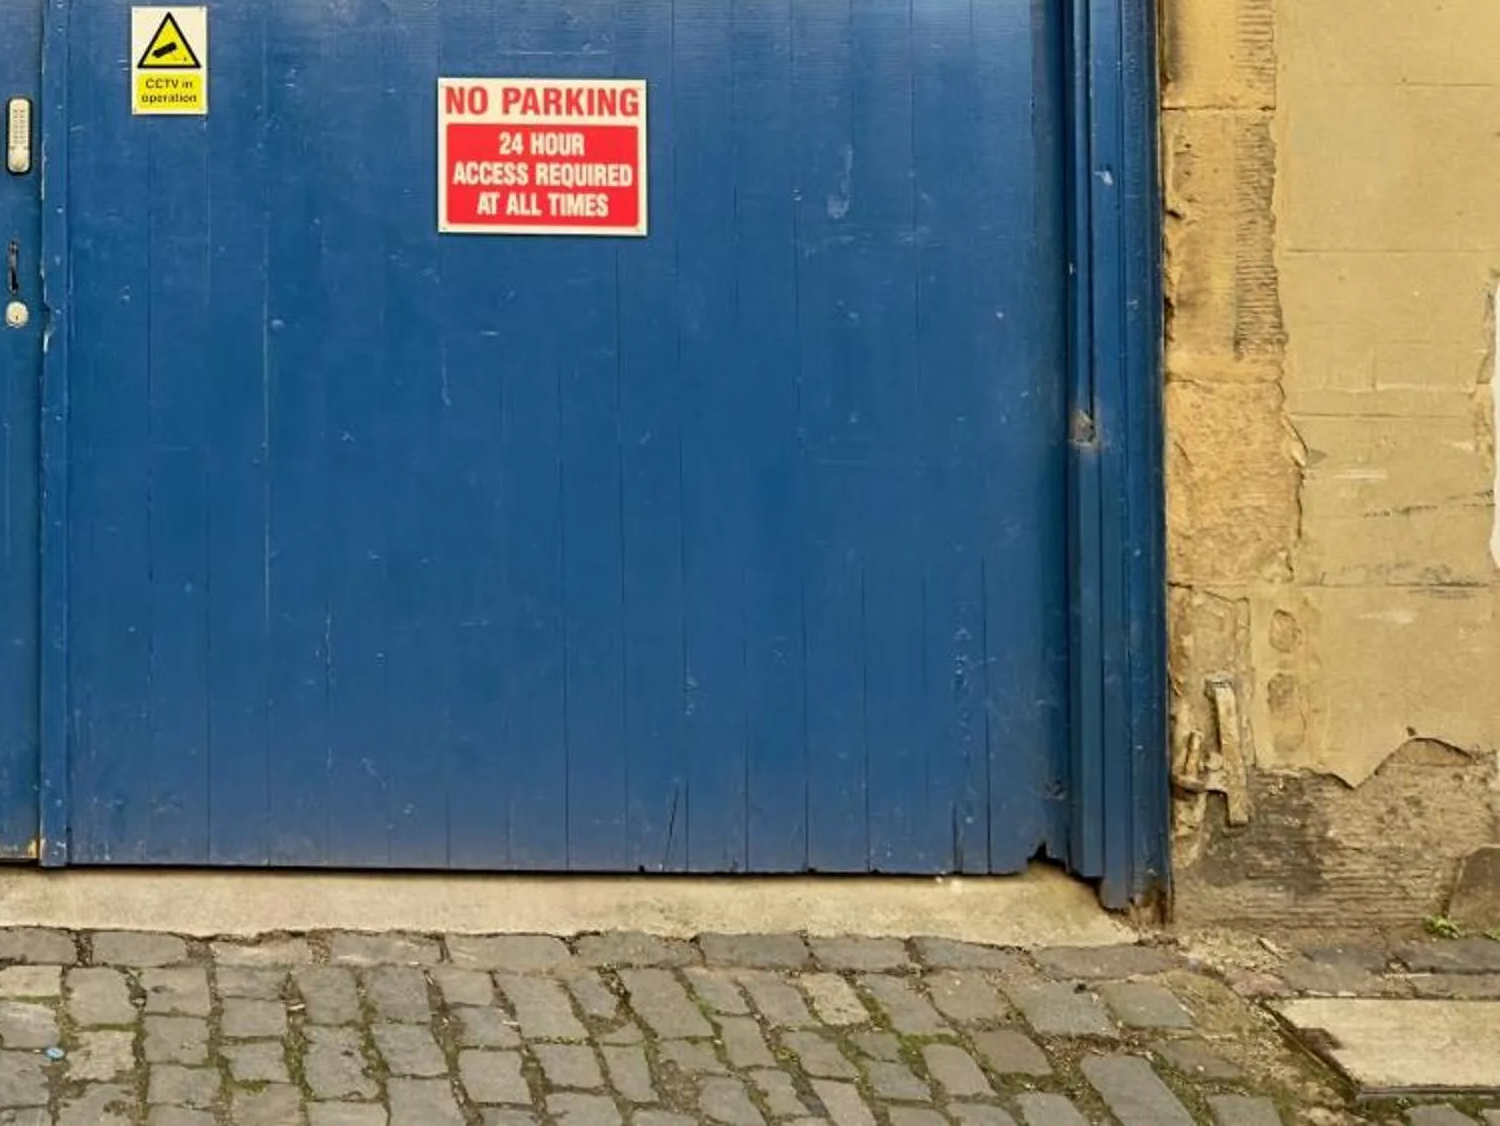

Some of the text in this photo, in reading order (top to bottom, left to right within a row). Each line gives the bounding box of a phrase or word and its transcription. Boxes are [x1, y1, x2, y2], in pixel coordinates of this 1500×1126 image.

[145, 78, 193, 89] CCTV in
[141, 94, 197, 105] operation
[444, 86, 639, 117] NO PARKING
[499, 132, 585, 156] 24 HOUR
[453, 161, 633, 188] ACCESS REQUIRED
[476, 192, 609, 217] AT ALL TIMES
